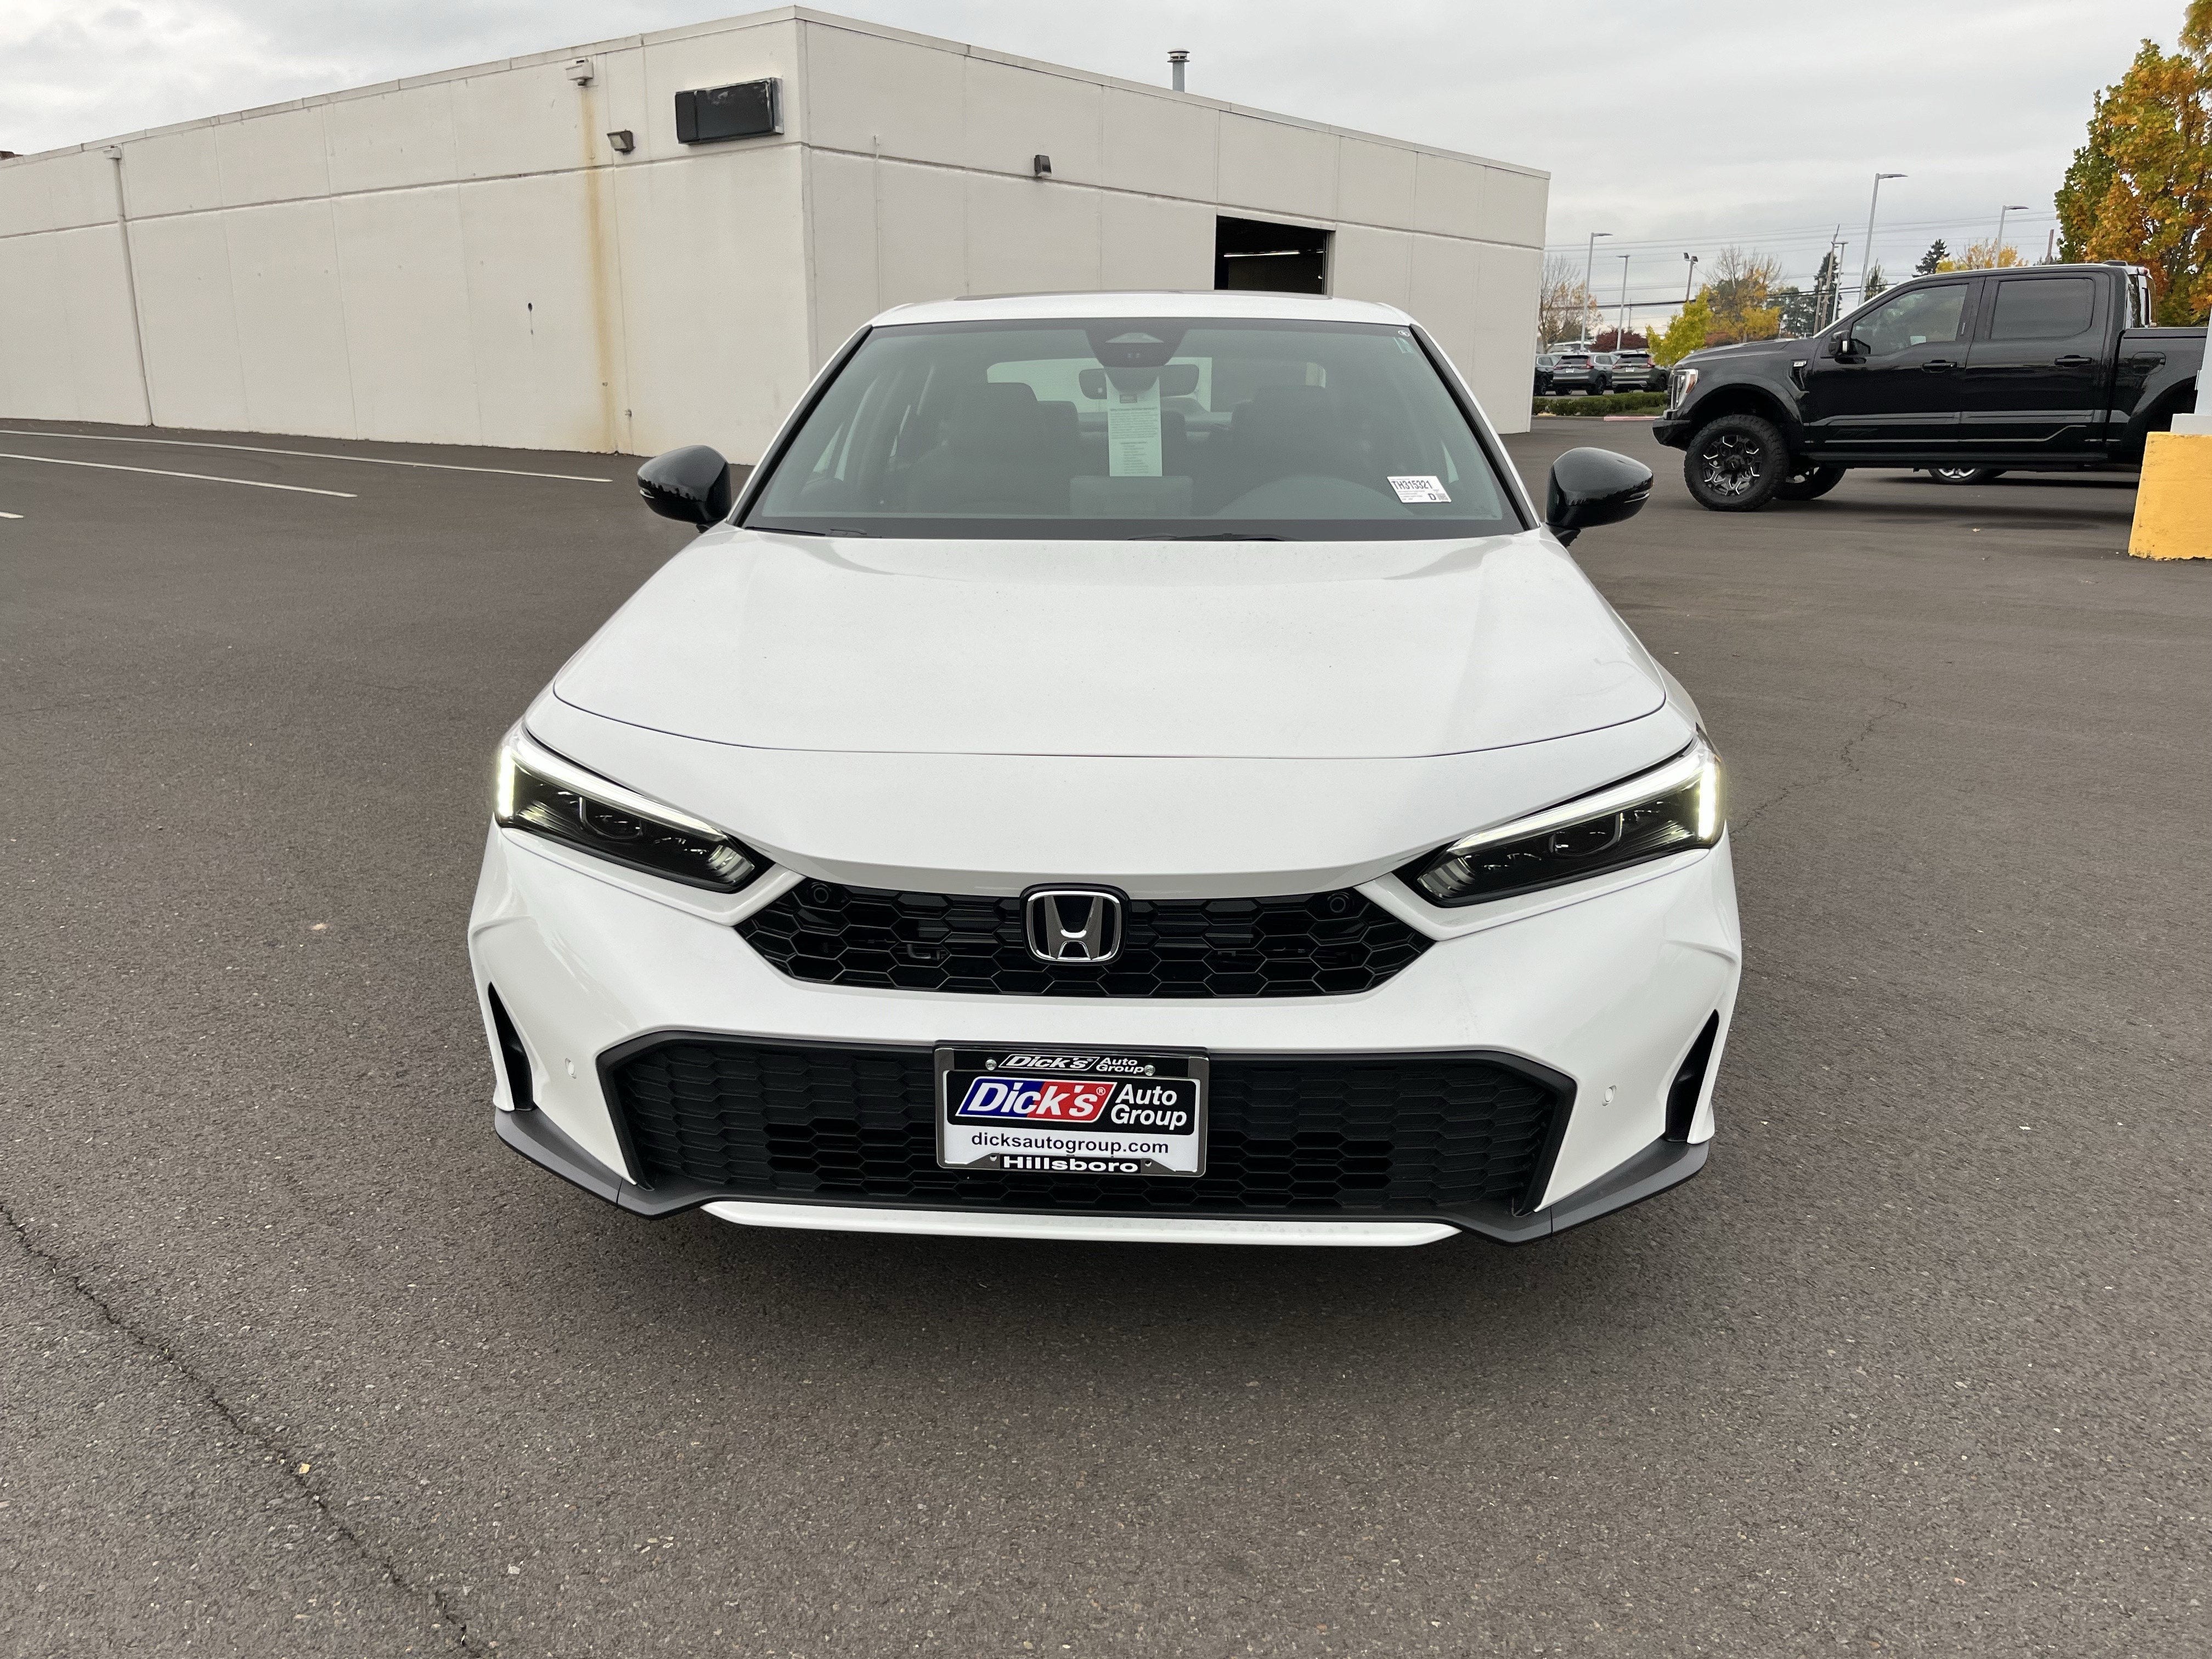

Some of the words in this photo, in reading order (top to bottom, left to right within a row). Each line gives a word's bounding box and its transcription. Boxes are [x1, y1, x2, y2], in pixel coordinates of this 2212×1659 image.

[1391, 480, 1432, 489] TH315321
[1006, 1056, 1088, 1069] Dick's
[1096, 1064, 1144, 1074] Group
[1099, 1057, 1137, 1065] Auto
[967, 1082, 1097, 1117] Dick's
[1115, 1084, 1177, 1105] Auto
[1110, 1104, 1187, 1130] Group
[972, 1132, 1169, 1154] dicksautogroup.com
[1003, 1156, 1138, 1172] Hillsboro
